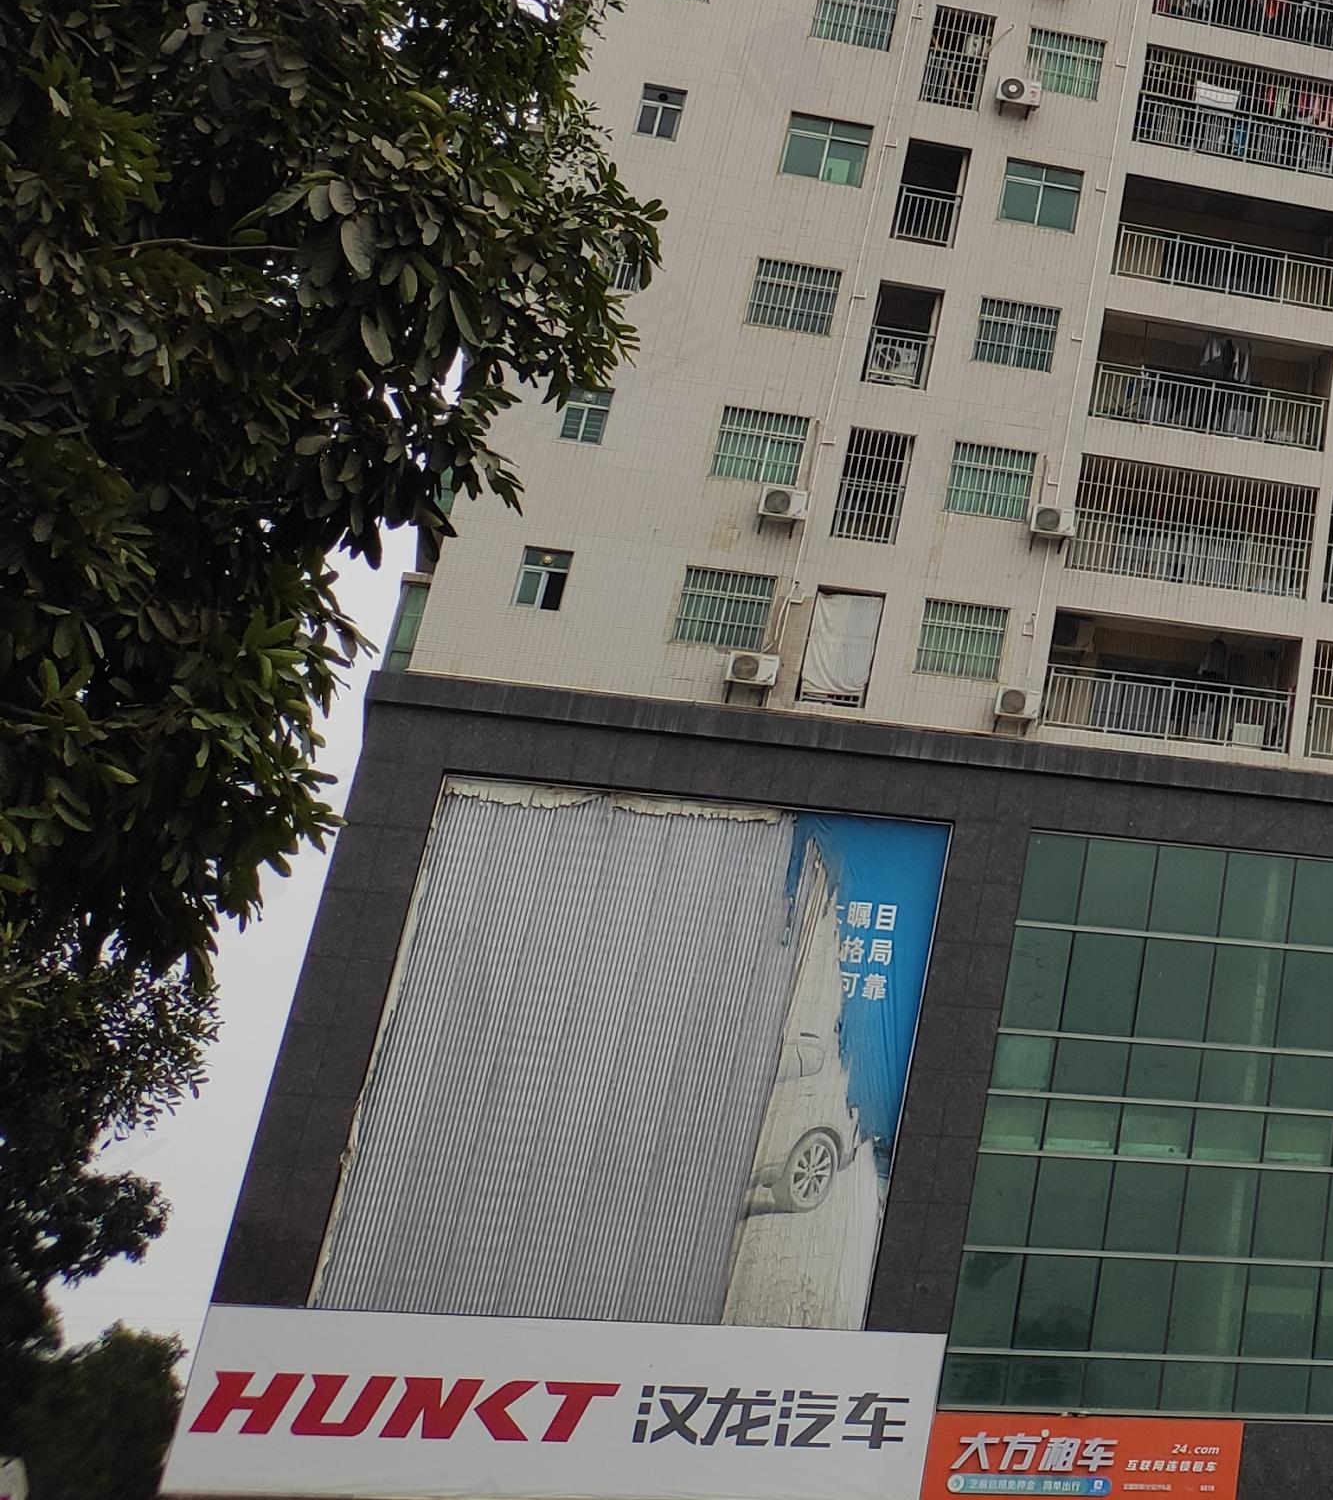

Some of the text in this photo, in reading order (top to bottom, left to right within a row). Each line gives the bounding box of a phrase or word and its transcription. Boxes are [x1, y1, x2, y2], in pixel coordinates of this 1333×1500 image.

[188, 1370, 622, 1444] HUNKT
[634, 1384, 910, 1450] 汉龙汽车
[950, 1431, 1120, 1472] 大方租车
[1171, 1443, 1220, 1456] 24.com
